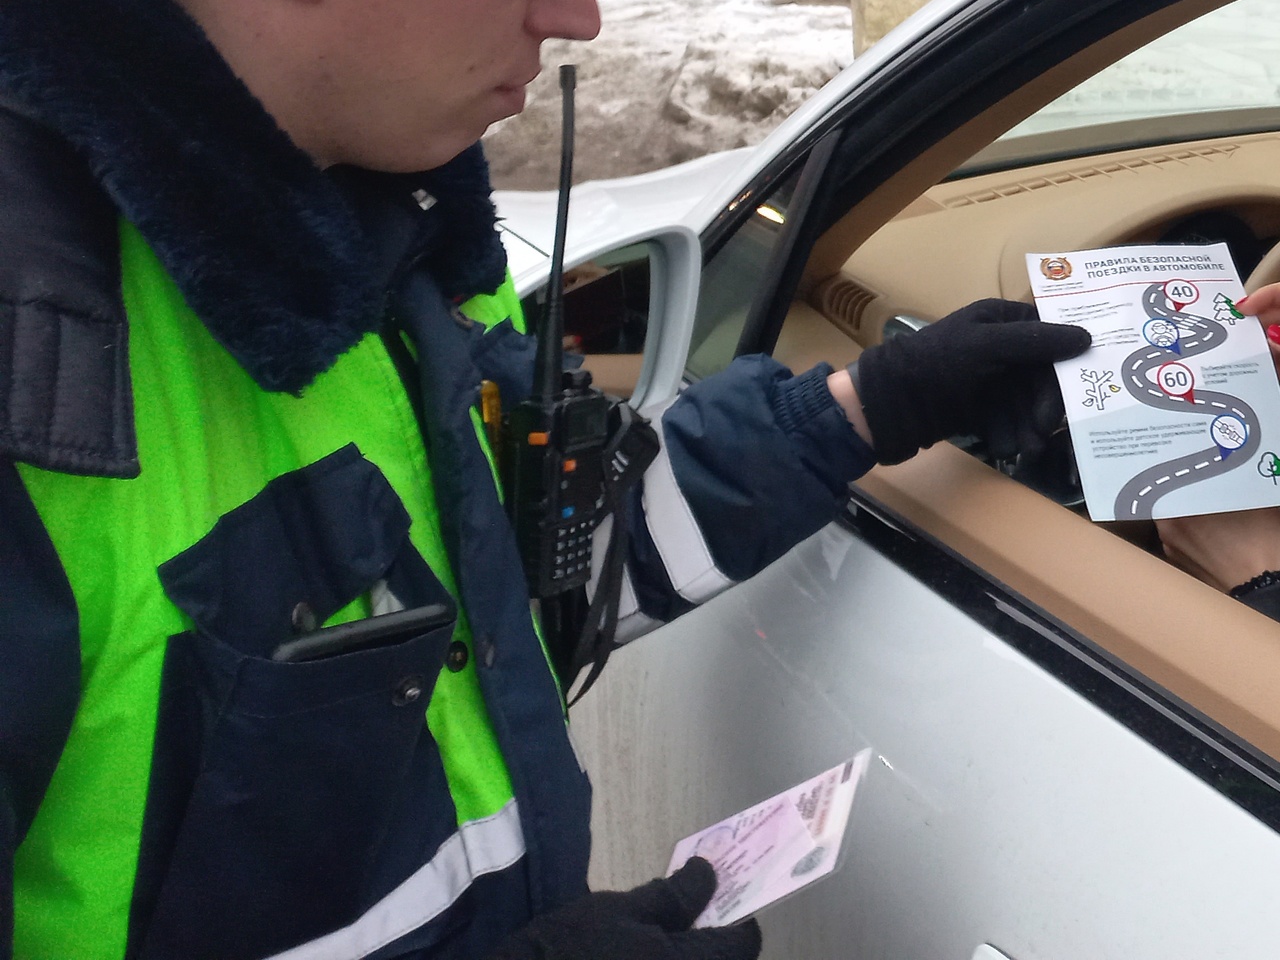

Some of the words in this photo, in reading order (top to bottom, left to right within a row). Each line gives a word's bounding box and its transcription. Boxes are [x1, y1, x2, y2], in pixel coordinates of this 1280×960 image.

[1084, 256, 1138, 270] ПРАВИЛА
[1139, 254, 1212, 264] БЕЗОПАСНОЙ
[1087, 265, 1141, 279] ПОЕЗДКИ
[1143, 264, 1151, 272] В
[1152, 263, 1226, 272] АВТОМОБИЛЕ
[1171, 286, 1194, 298] 40
[1164, 371, 1188, 388] 60
